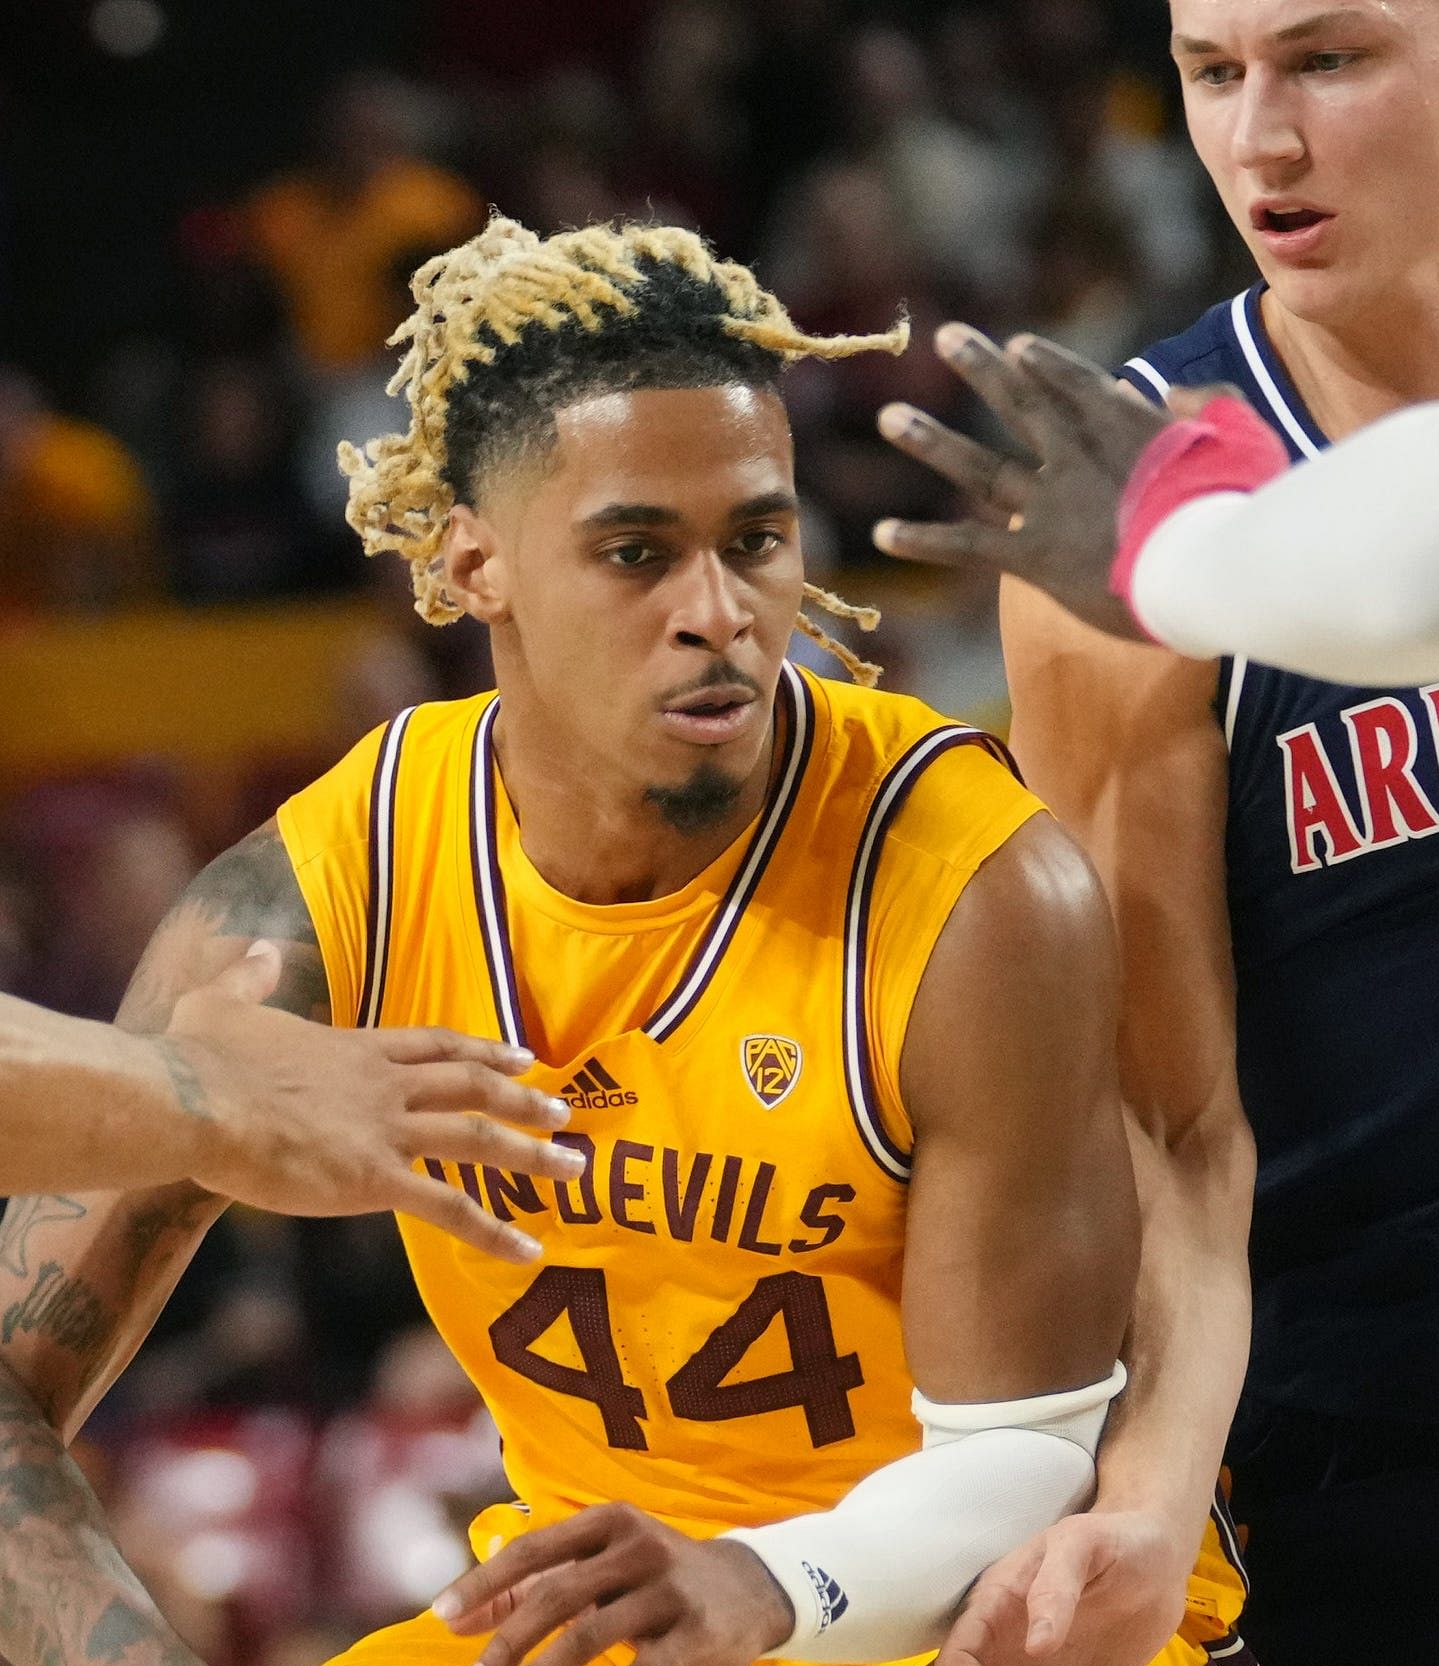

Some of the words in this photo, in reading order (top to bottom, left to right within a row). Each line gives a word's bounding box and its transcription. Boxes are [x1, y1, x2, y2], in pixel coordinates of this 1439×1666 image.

[744, 1037, 797, 1082] PAC
[757, 1067, 784, 1095] 12
[488, 1265, 865, 1451] 44
